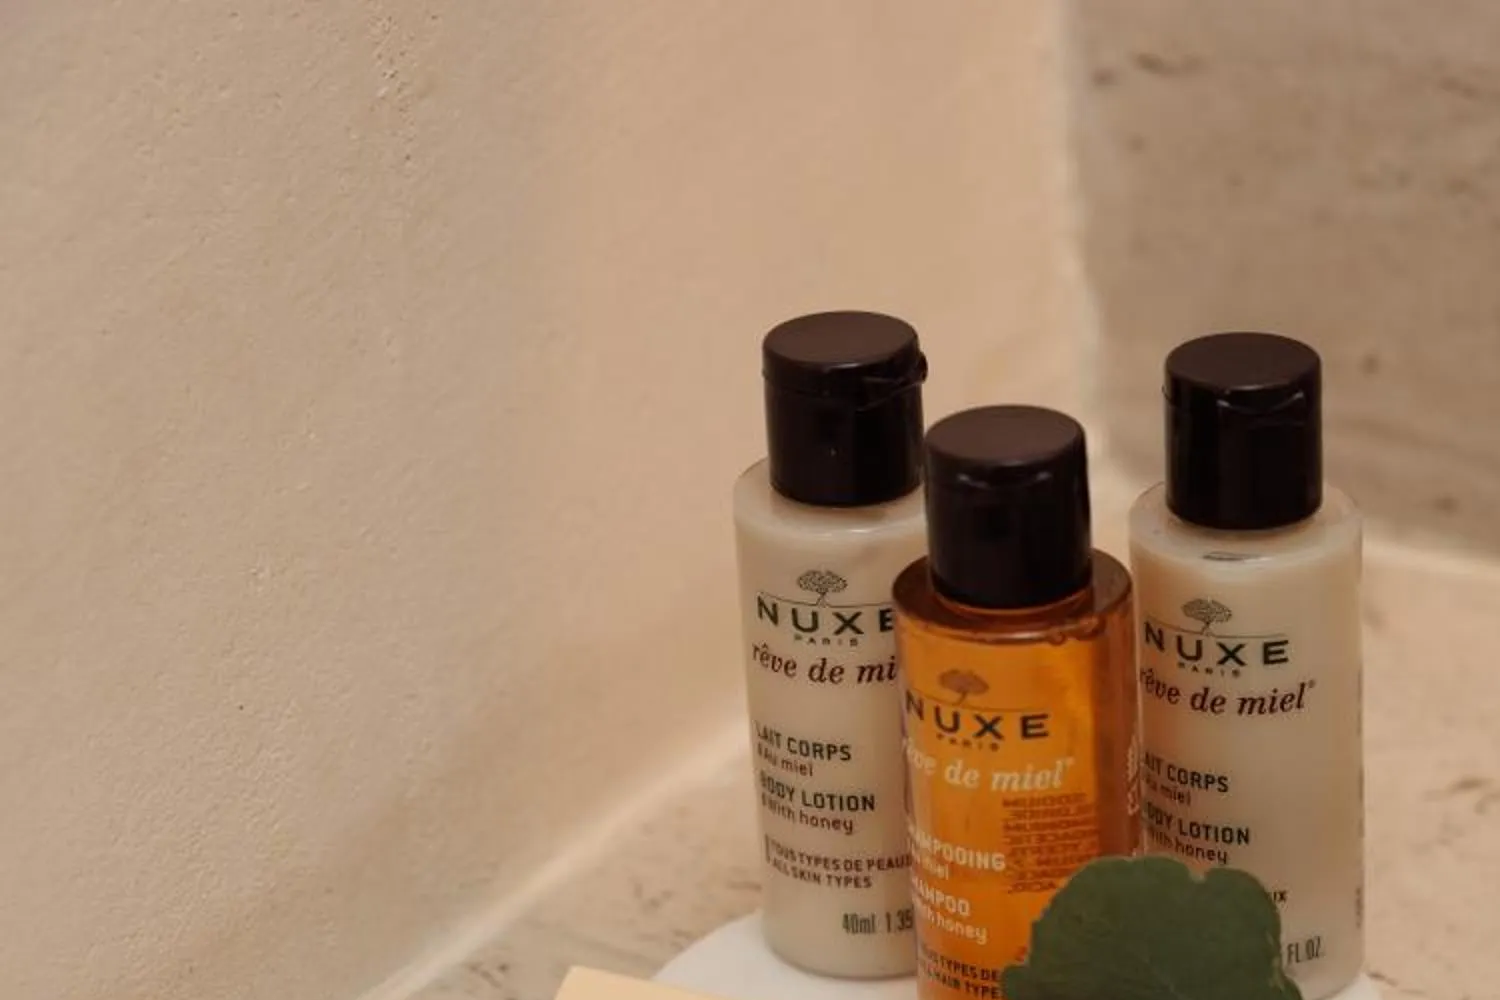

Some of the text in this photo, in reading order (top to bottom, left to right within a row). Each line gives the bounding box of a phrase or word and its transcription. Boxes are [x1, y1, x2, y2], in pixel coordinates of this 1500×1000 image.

[757, 596, 894, 635] NUXE
[1144, 621, 1290, 667] NUXE
[752, 643, 897, 684] rêve de mi
[1140, 667, 1181, 705] rêve
[1190, 686, 1227, 714] de
[905, 689, 1050, 741] NUXE
[787, 737, 852, 761] CORPS
[781, 757, 814, 777] miel
[944, 759, 980, 789] de
[1166, 763, 1230, 792] CORPS
[760, 769, 876, 812] BODY LOTION
[799, 809, 854, 835] honey
[1146, 800, 1251, 846] ODY LOTION
[799, 850, 840, 871] TYPES
[843, 855, 865, 872] DE
[1174, 835, 1228, 865] honey
[791, 865, 822, 884] SKIN
[827, 873, 873, 889] TYPES
[842, 911, 876, 935] 40ml
[936, 911, 988, 946] honey
[940, 955, 978, 979] TYPES
